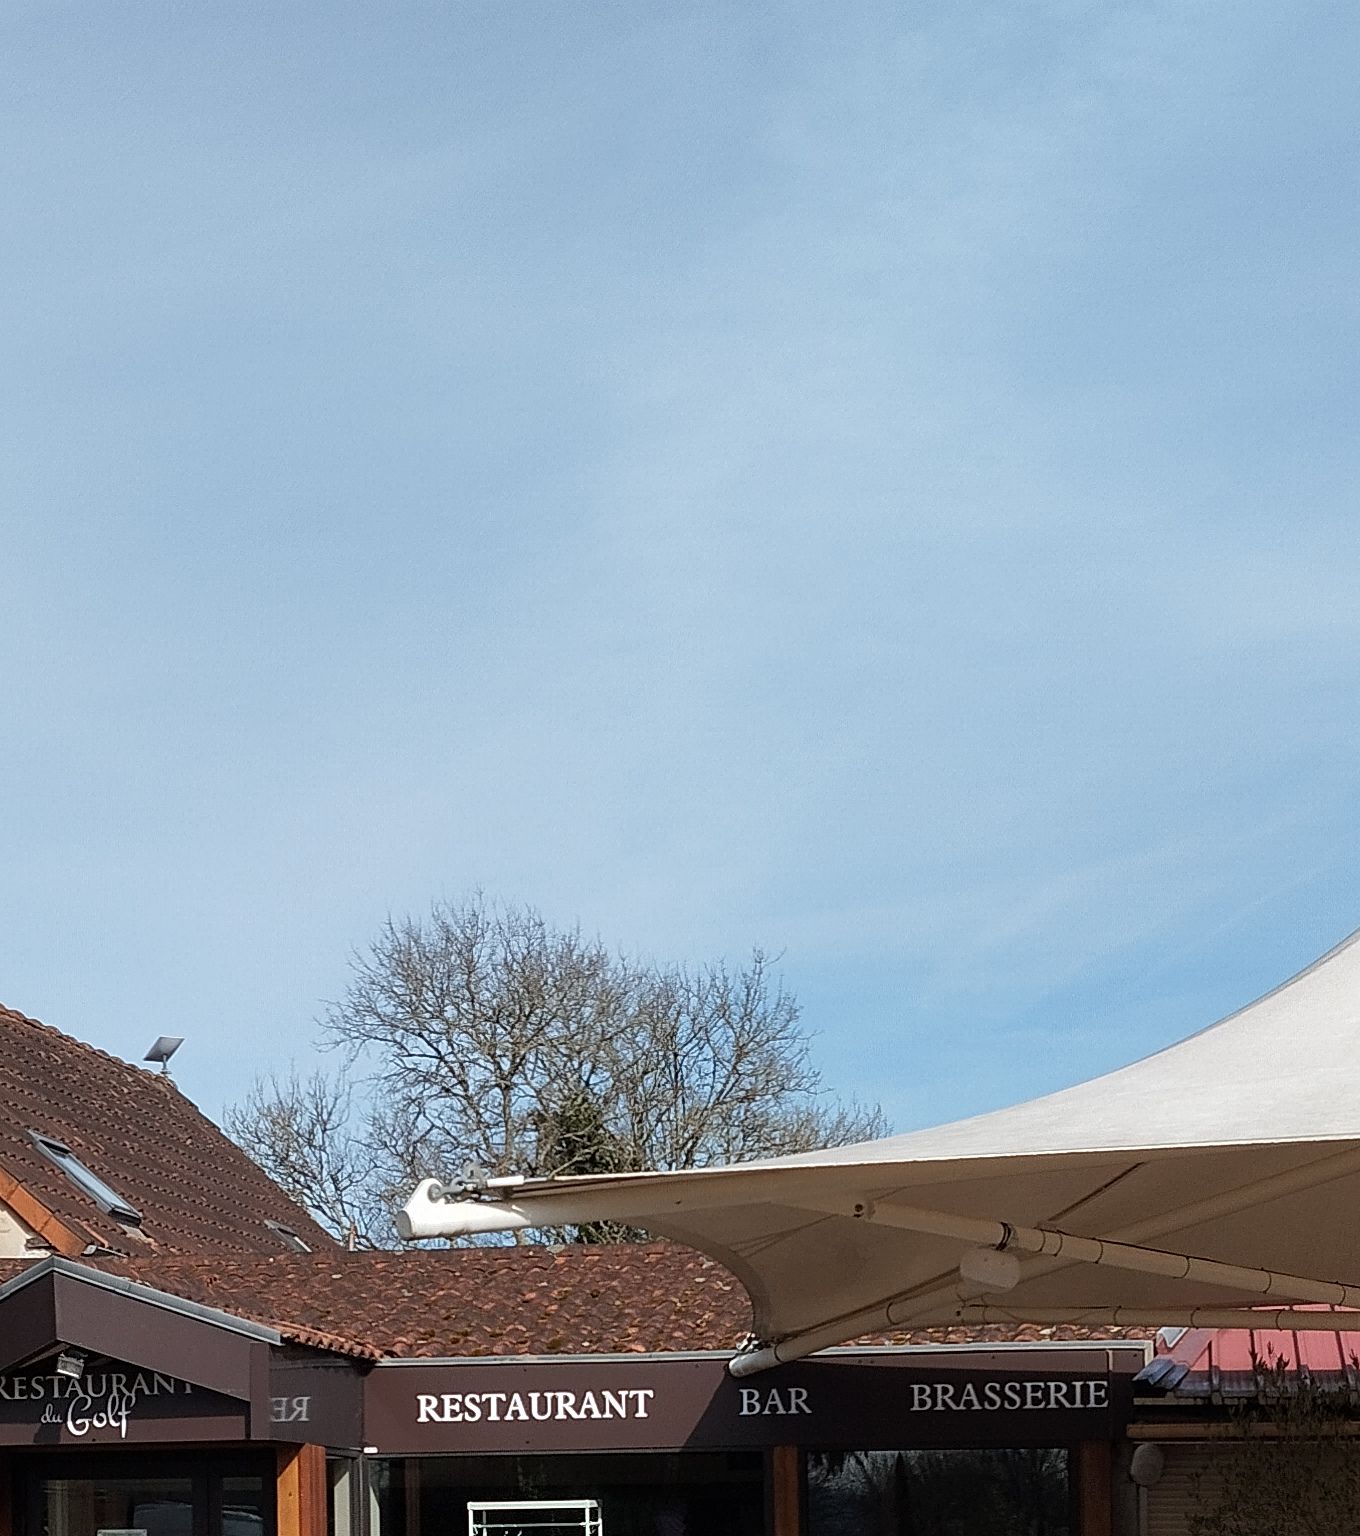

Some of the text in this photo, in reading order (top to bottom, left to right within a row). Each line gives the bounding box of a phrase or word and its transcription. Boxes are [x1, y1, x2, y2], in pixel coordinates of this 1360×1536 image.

[416, 1388, 655, 1423] RESTAURANT
[739, 1387, 813, 1416] BAR
[909, 1380, 1110, 1412] BRASSERIE
[40, 1393, 137, 1439] du Golf
